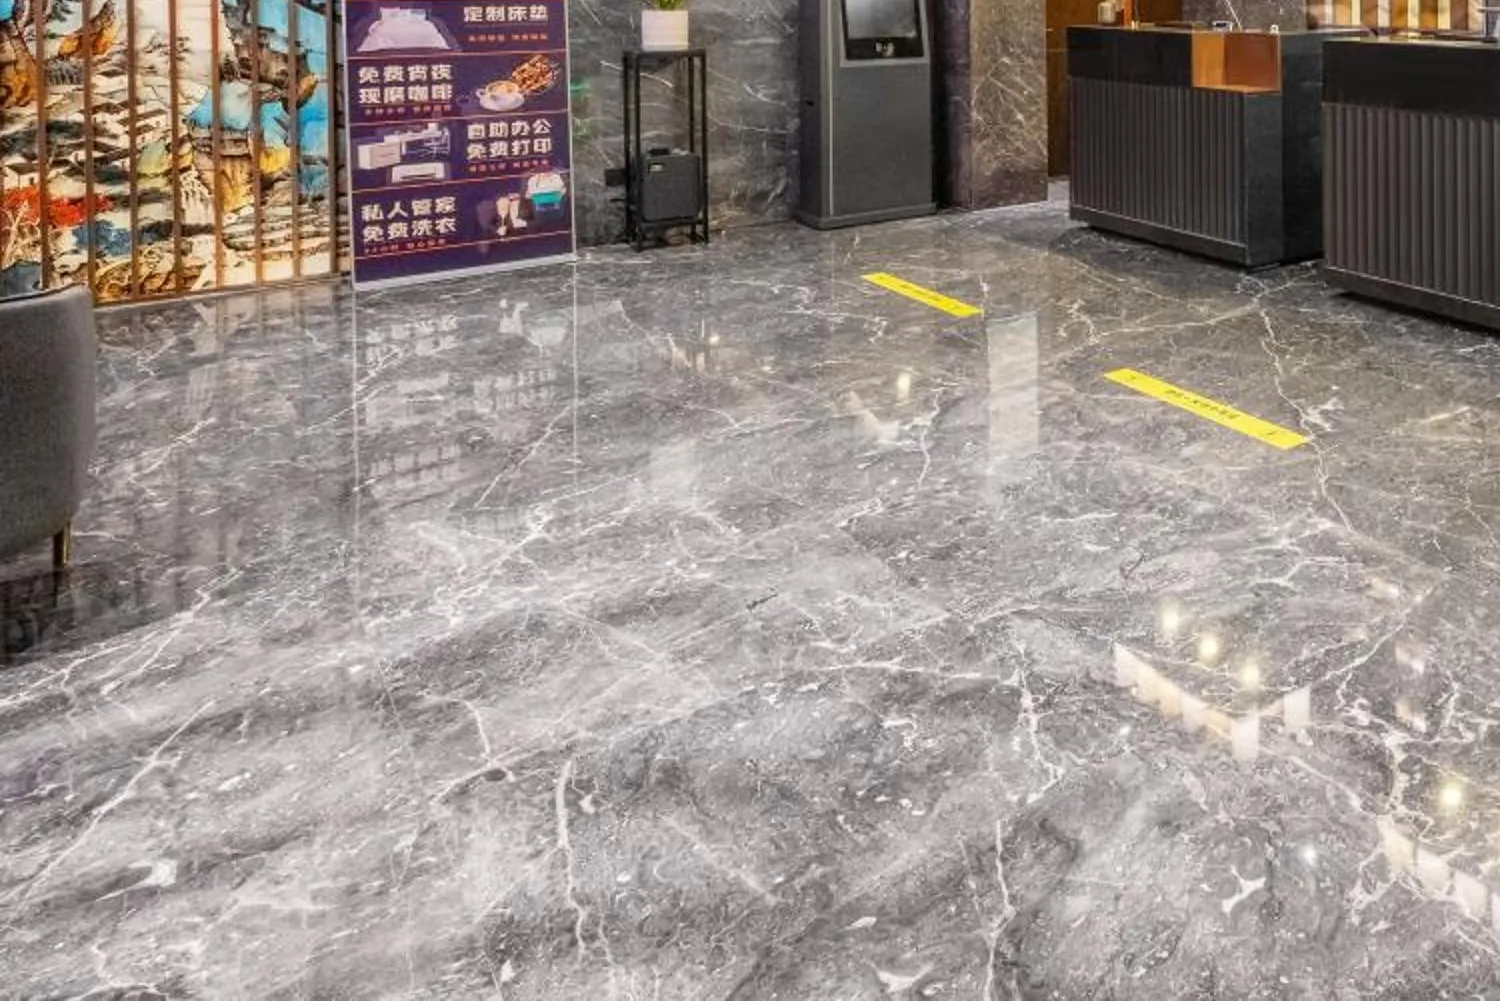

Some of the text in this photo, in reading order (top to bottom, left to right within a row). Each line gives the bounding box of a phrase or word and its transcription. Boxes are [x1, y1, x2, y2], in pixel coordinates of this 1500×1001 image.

[463, 4, 548, 23] 定制床垫
[358, 64, 452, 84] 免费宵夜
[358, 83, 452, 104] 现磨咖啡
[467, 118, 552, 140] 自助办公
[467, 137, 552, 160] 免费打印
[361, 196, 456, 222] 私人管家
[363, 217, 456, 242] 免费洗衣
